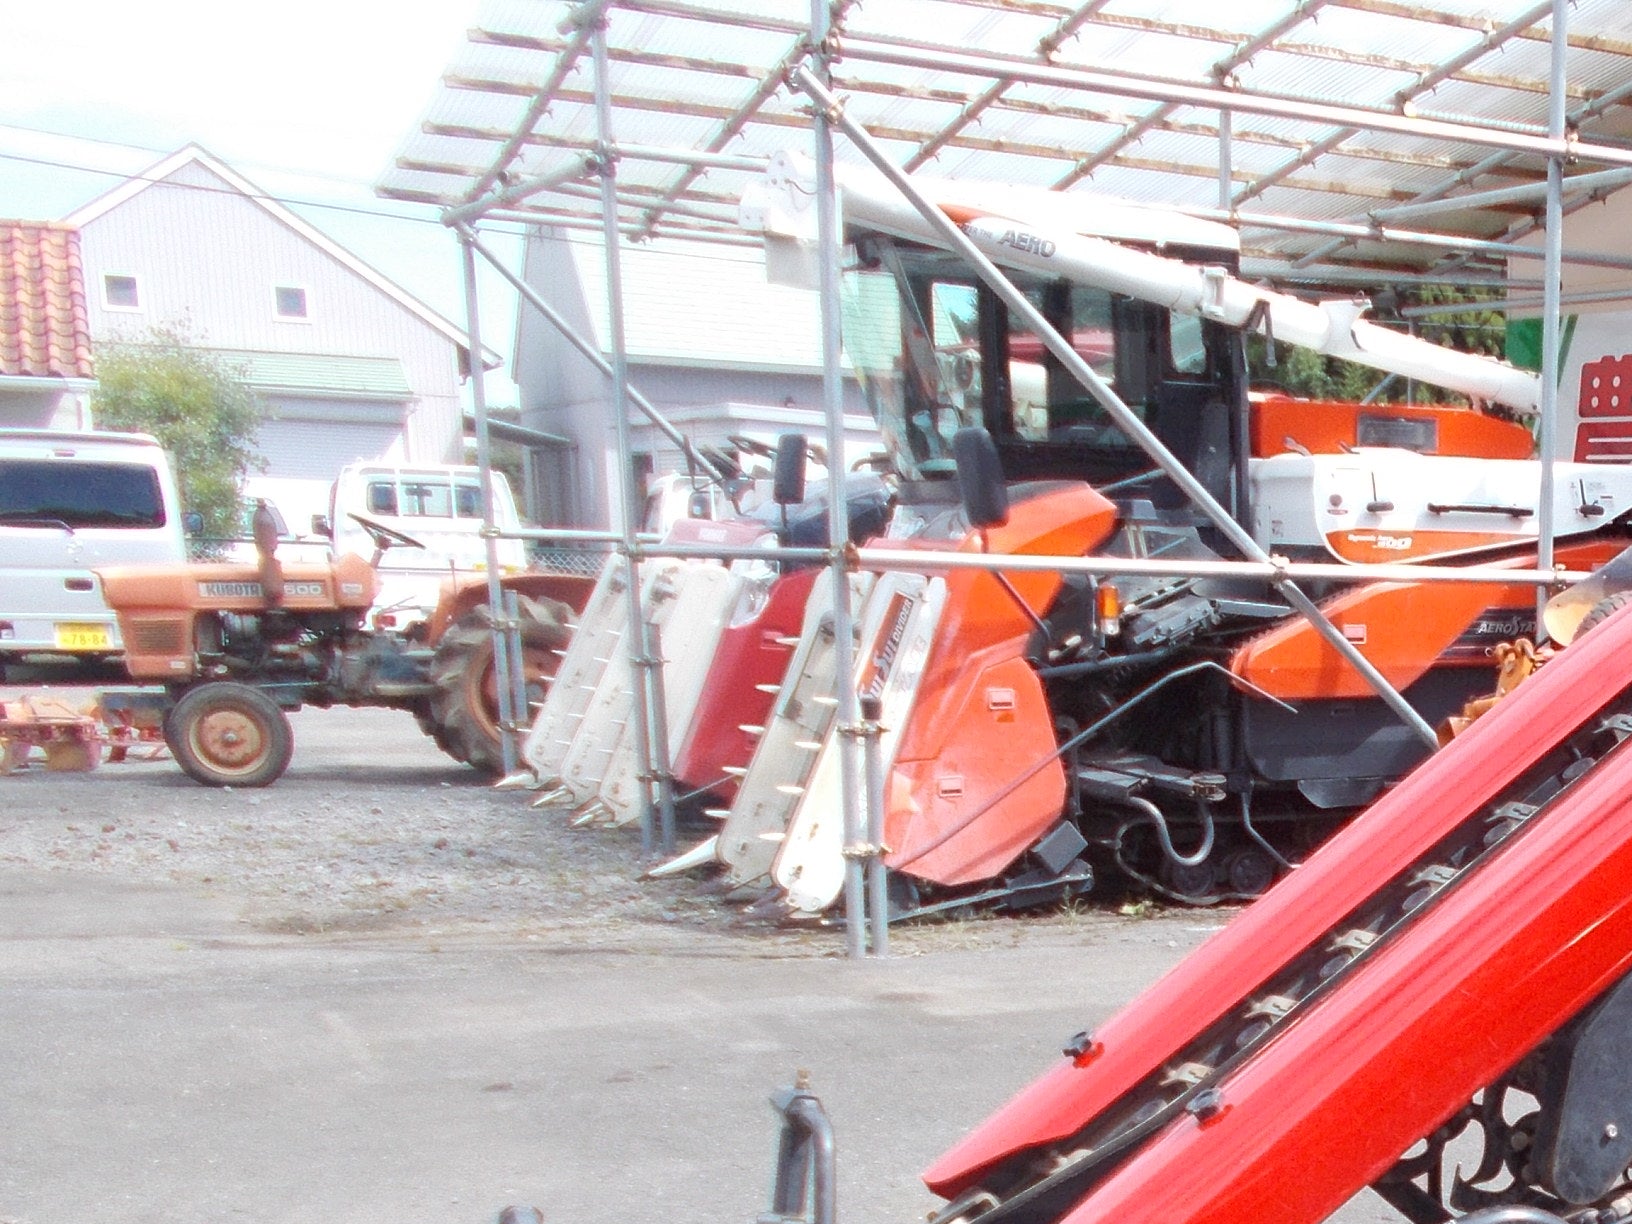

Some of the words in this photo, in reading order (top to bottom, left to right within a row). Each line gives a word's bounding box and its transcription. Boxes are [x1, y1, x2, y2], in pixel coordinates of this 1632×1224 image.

[997, 230, 1056, 257] AERO
[205, 582, 260, 597] KUBOTA
[892, 599, 912, 643] DIVIDER
[1475, 615, 1537, 636] AEROSTA
